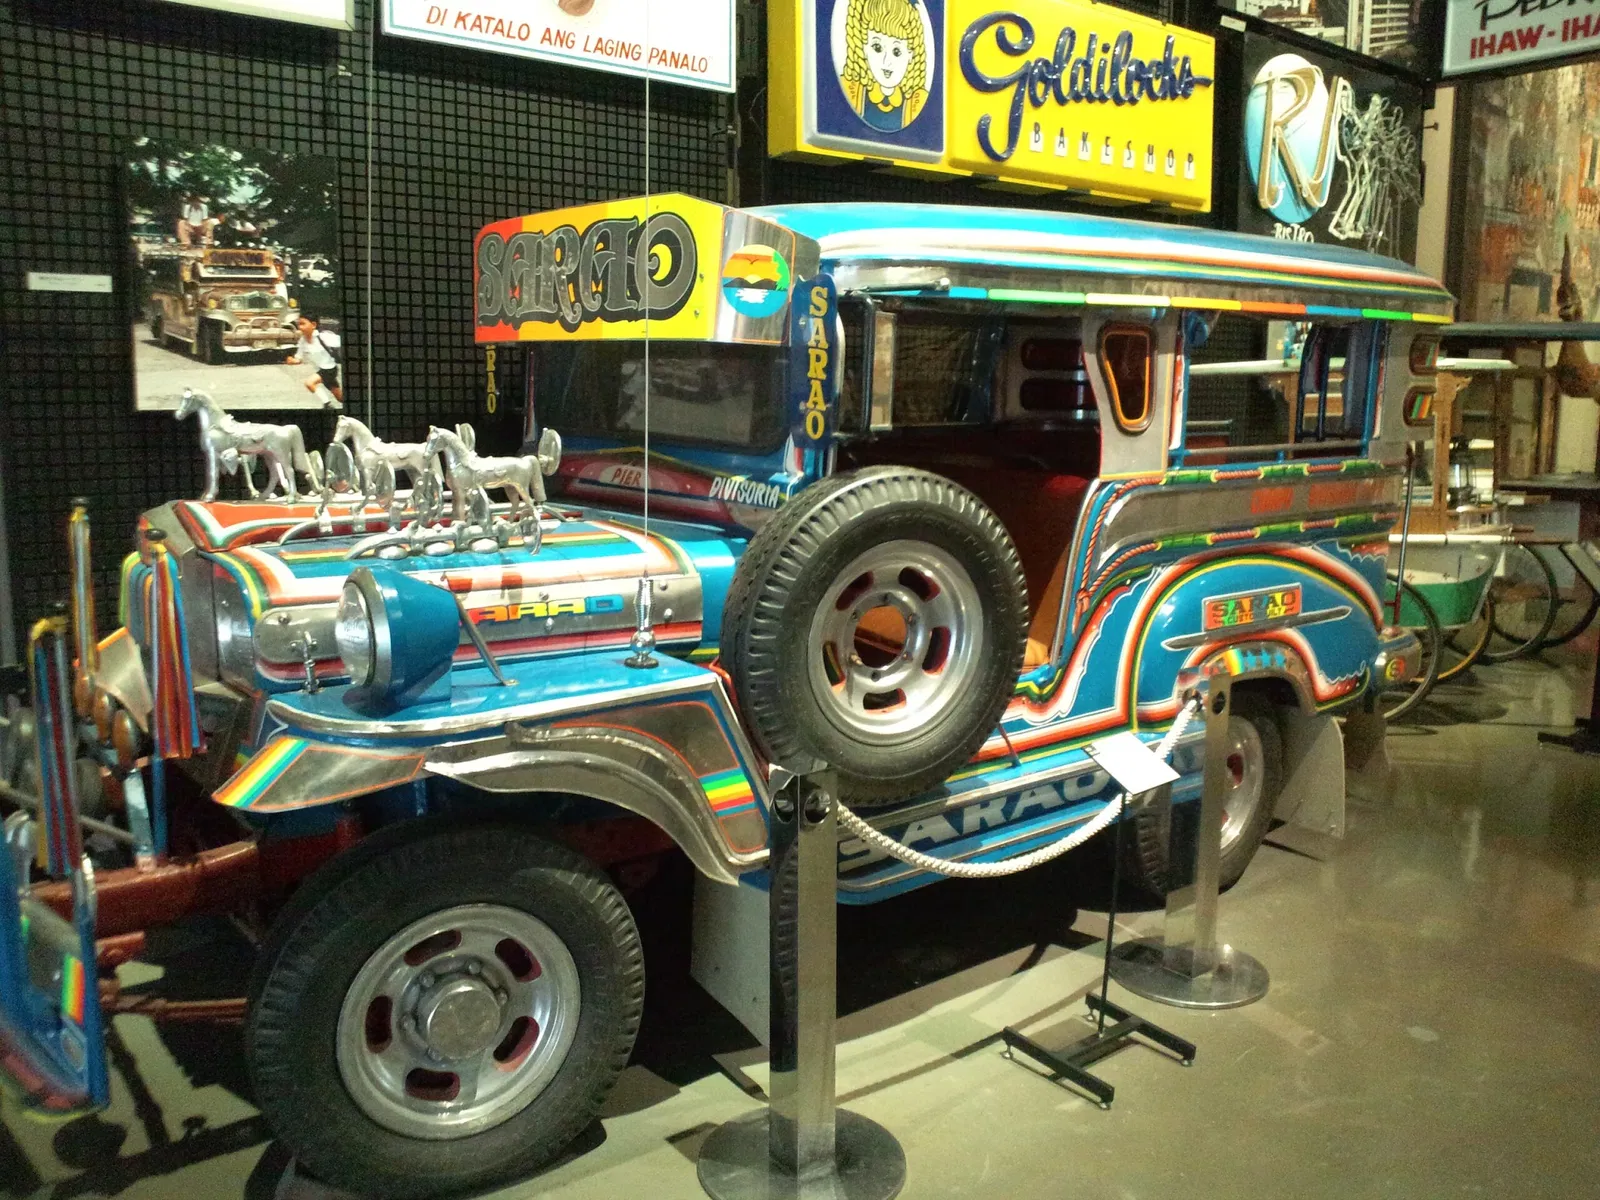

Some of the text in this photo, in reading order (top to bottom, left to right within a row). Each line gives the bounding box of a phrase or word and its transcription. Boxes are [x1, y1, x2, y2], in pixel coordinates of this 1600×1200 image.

[425, 5, 449, 27] DI
[453, 11, 531, 42] KATALO
[539, 27, 577, 50] ANG
[582, 37, 643, 62] LAGING
[1470, 24, 1545, 59] IHAW
[959, 11, 1214, 162] Goldilocks
[1033, 121, 1194, 171] BAKESHOP
[477, 211, 698, 331] SARAO
[805, 286, 830, 440] SARAO
[611, 467, 642, 487] PIER
[708, 476, 781, 509] DIVISORIA
[467, 593, 624, 626] ARAO
[1211, 591, 1297, 617] SARAO
[837, 770, 1111, 874] SARAO
